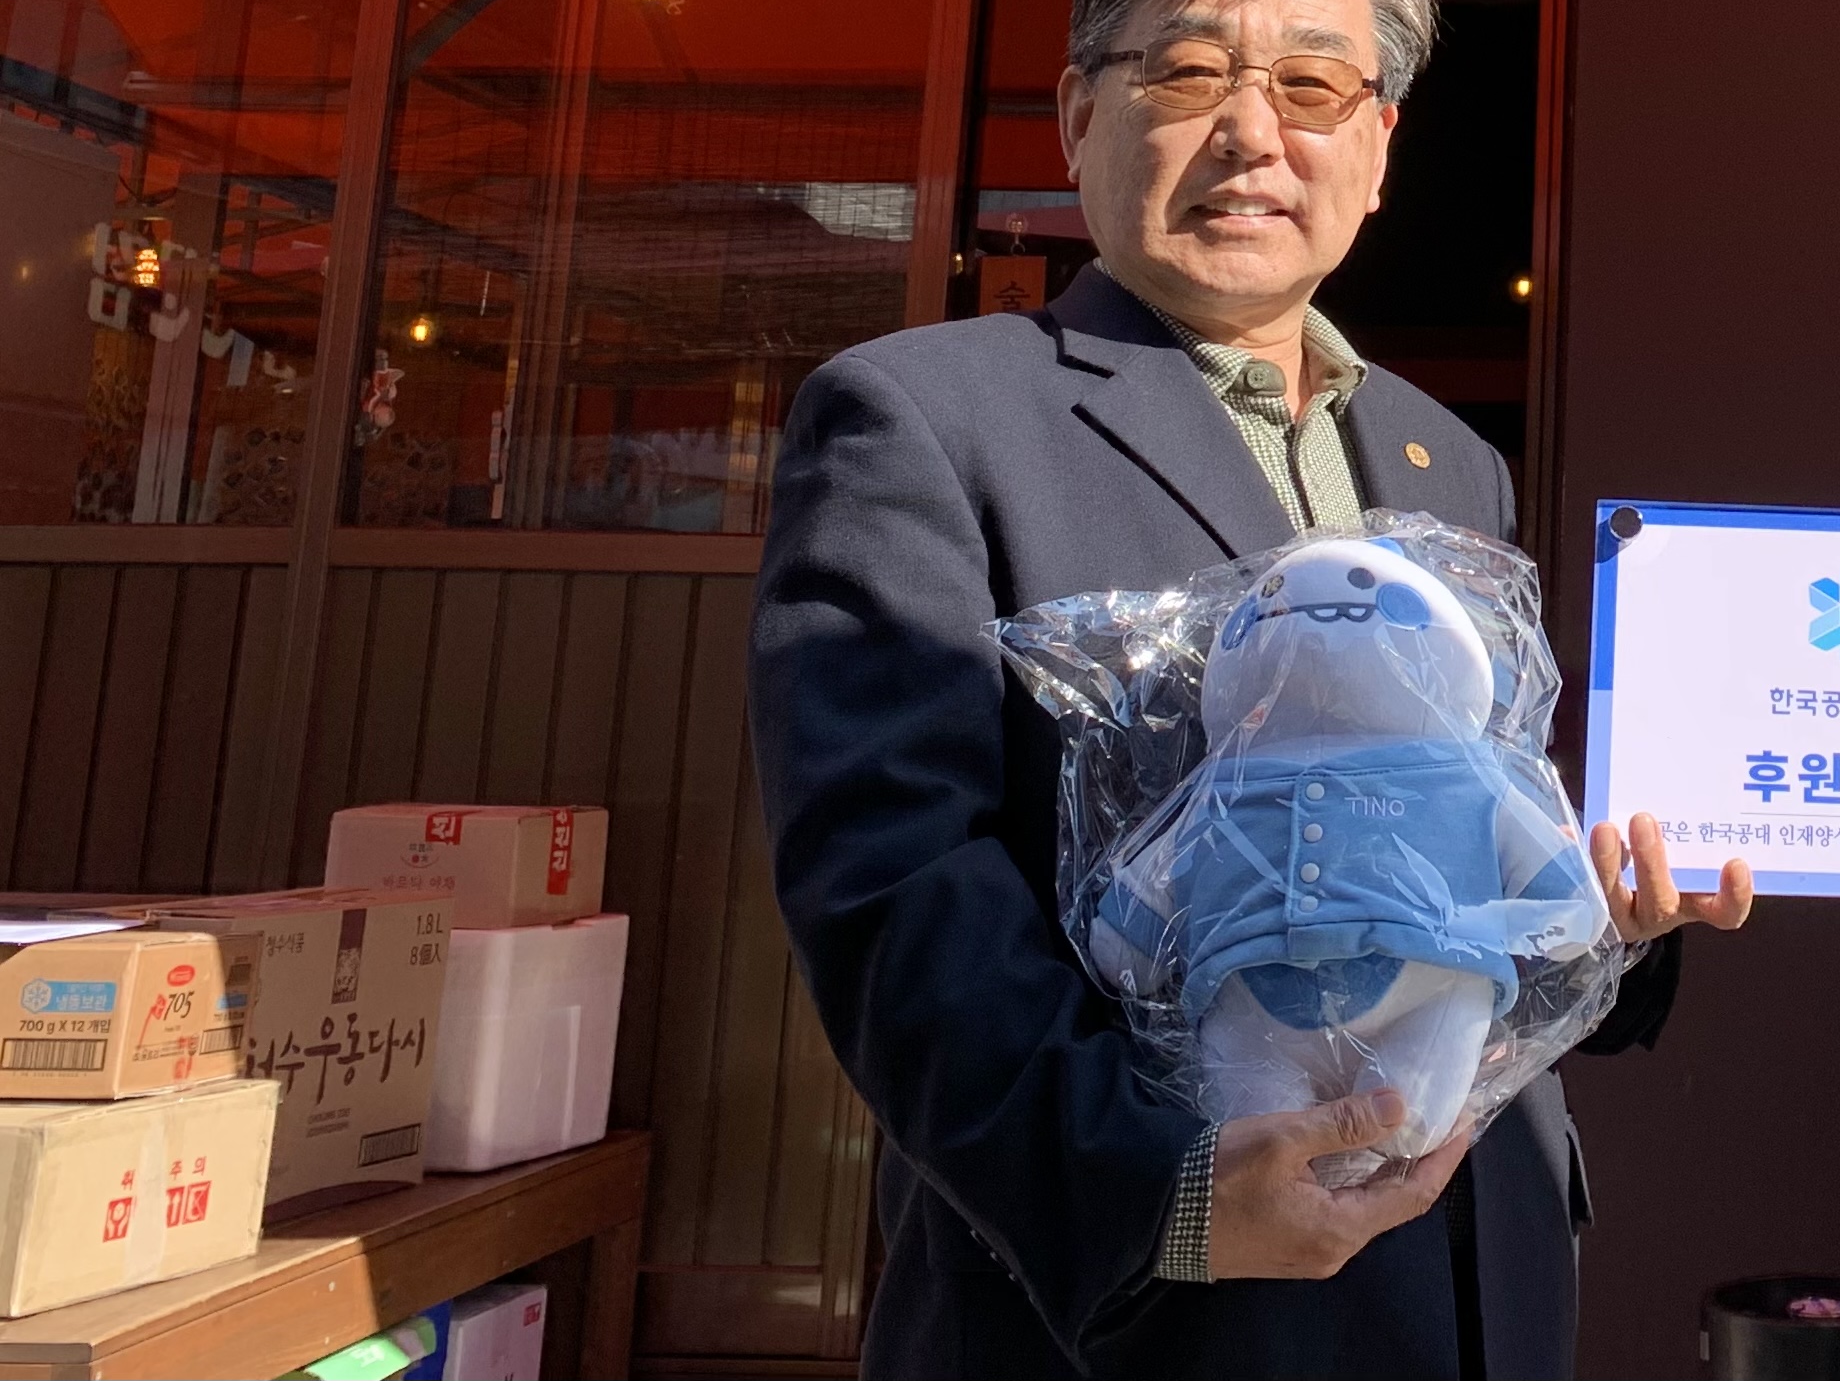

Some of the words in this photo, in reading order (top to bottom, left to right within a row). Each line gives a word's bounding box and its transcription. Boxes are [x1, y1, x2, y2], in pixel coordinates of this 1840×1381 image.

[1344, 796, 1406, 818] TINO
[1698, 822, 1771, 846] 한국공대
[56, 994, 108, 1011] 냉동보관
[19, 1020, 44, 1032] 700
[71, 1020, 84, 1032] 12
[87, 1019, 111, 1033] 개입
